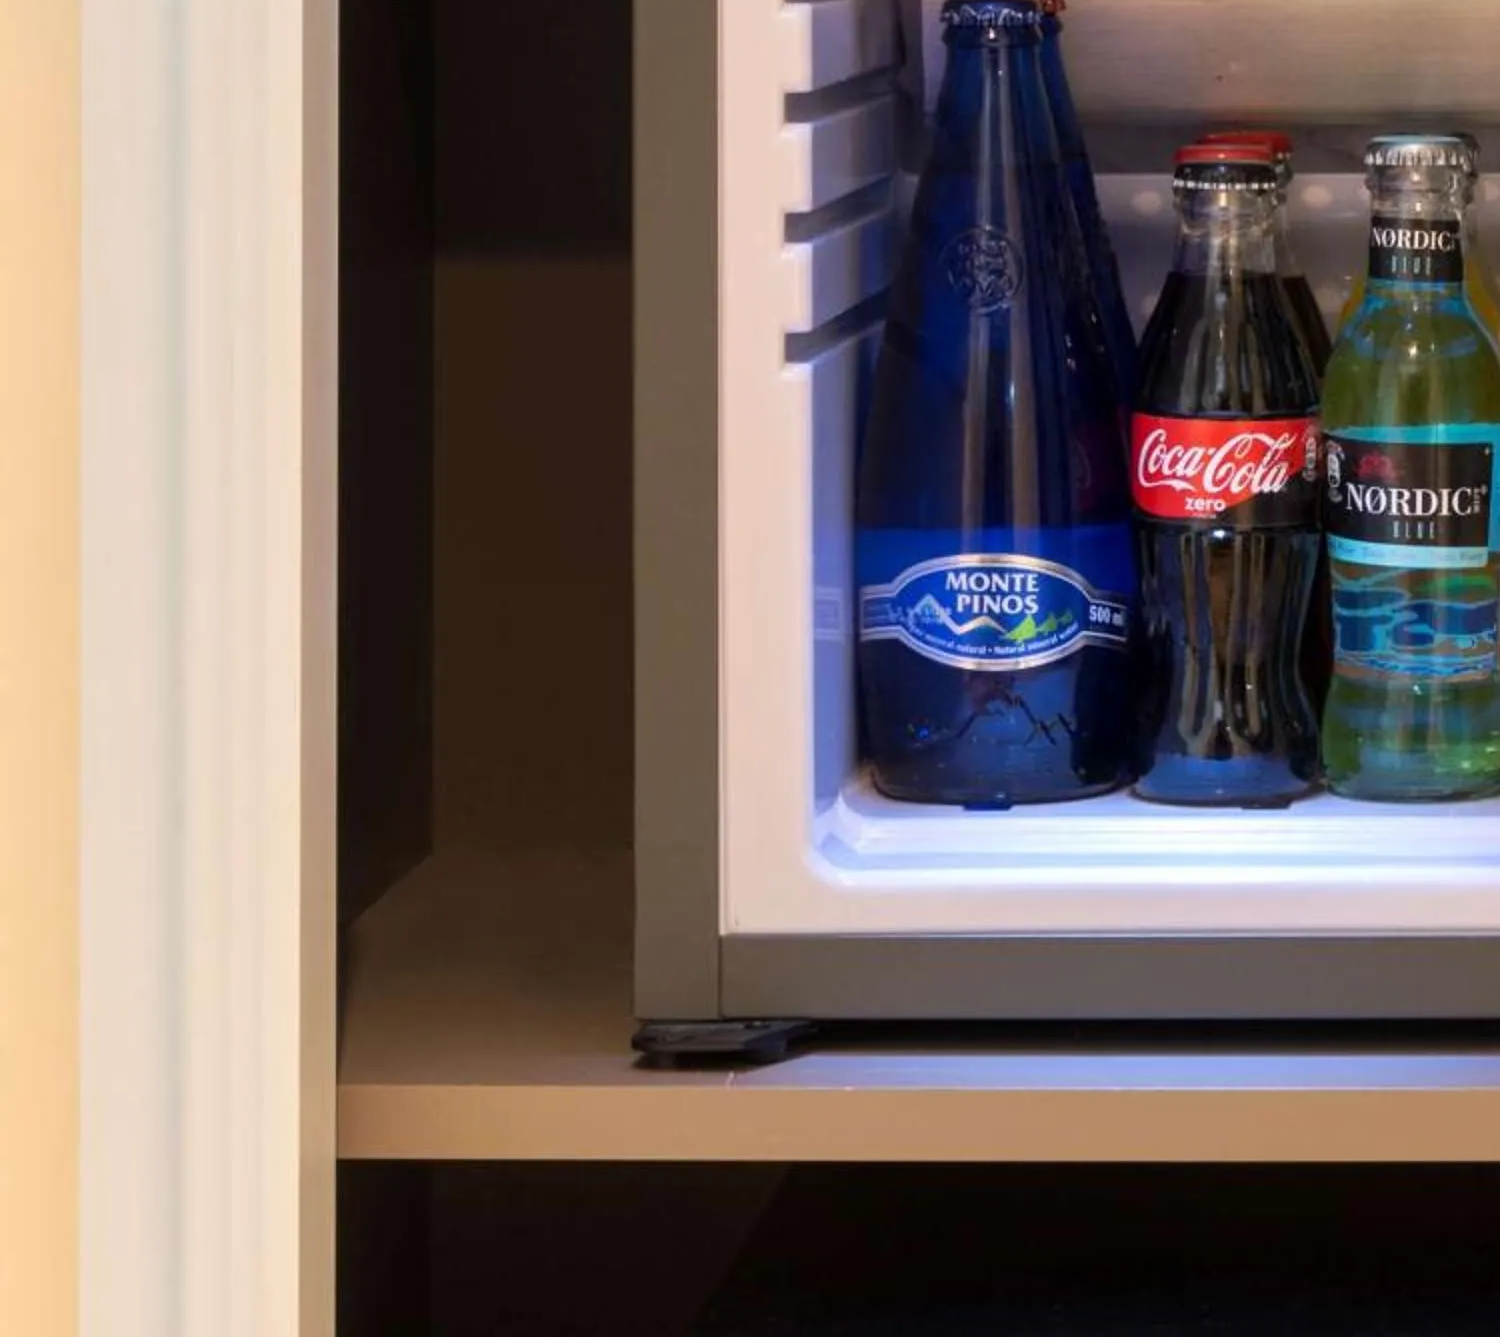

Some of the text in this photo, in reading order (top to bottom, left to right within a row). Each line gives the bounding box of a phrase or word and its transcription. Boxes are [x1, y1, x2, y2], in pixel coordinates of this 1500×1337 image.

[1138, 428, 1297, 494] Coca-Cola
[1185, 497, 1226, 512] zero
[1345, 482, 1472, 517] NØRDIC
[945, 572, 1040, 592] MONTE
[955, 594, 1040, 614] PINOS
[1089, 605, 1111, 623] 500
